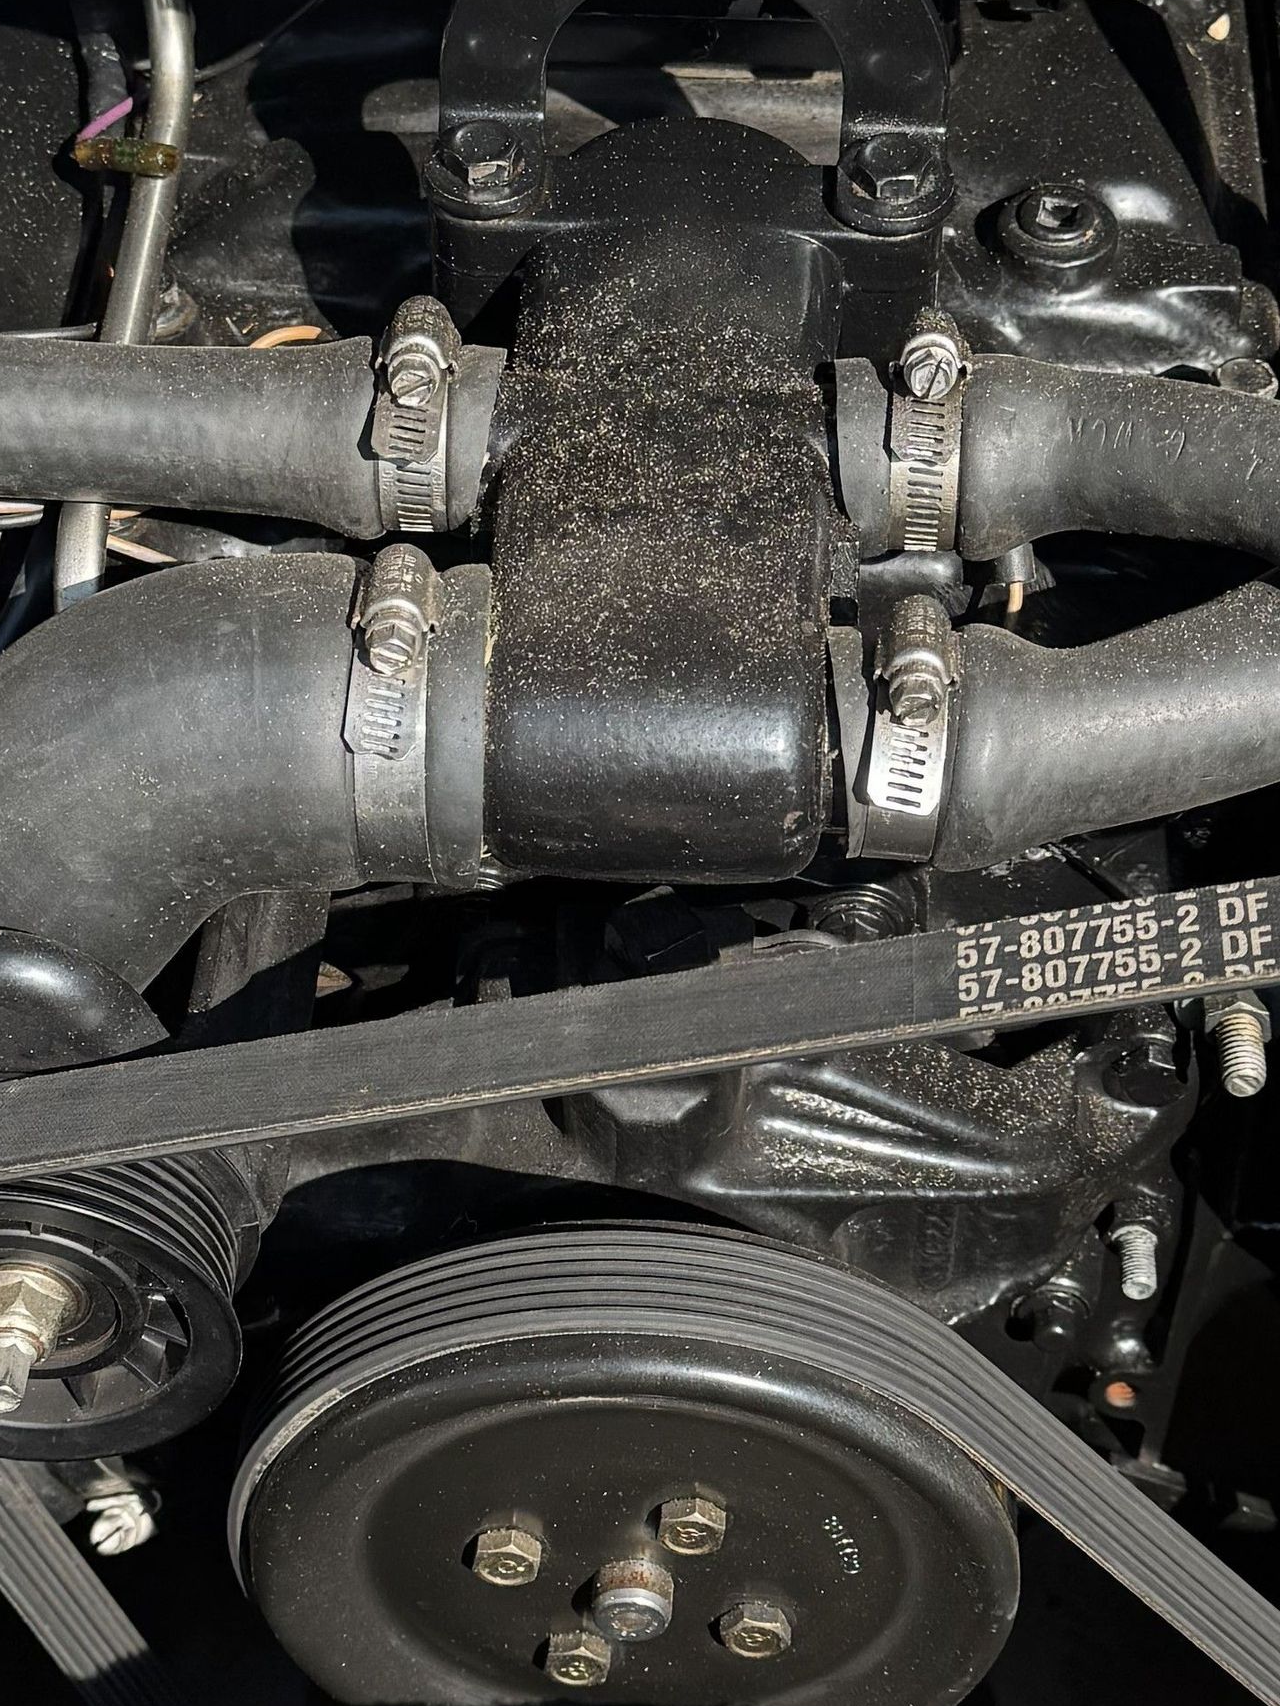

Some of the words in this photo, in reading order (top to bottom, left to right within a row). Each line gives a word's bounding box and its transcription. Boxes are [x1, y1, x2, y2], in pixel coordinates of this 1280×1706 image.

[957, 904, 1200, 970] 57-807755-2
[1218, 891, 1269, 927] DF
[958, 937, 1203, 1002] 57-807755-2
[1222, 925, 1272, 960] DF
